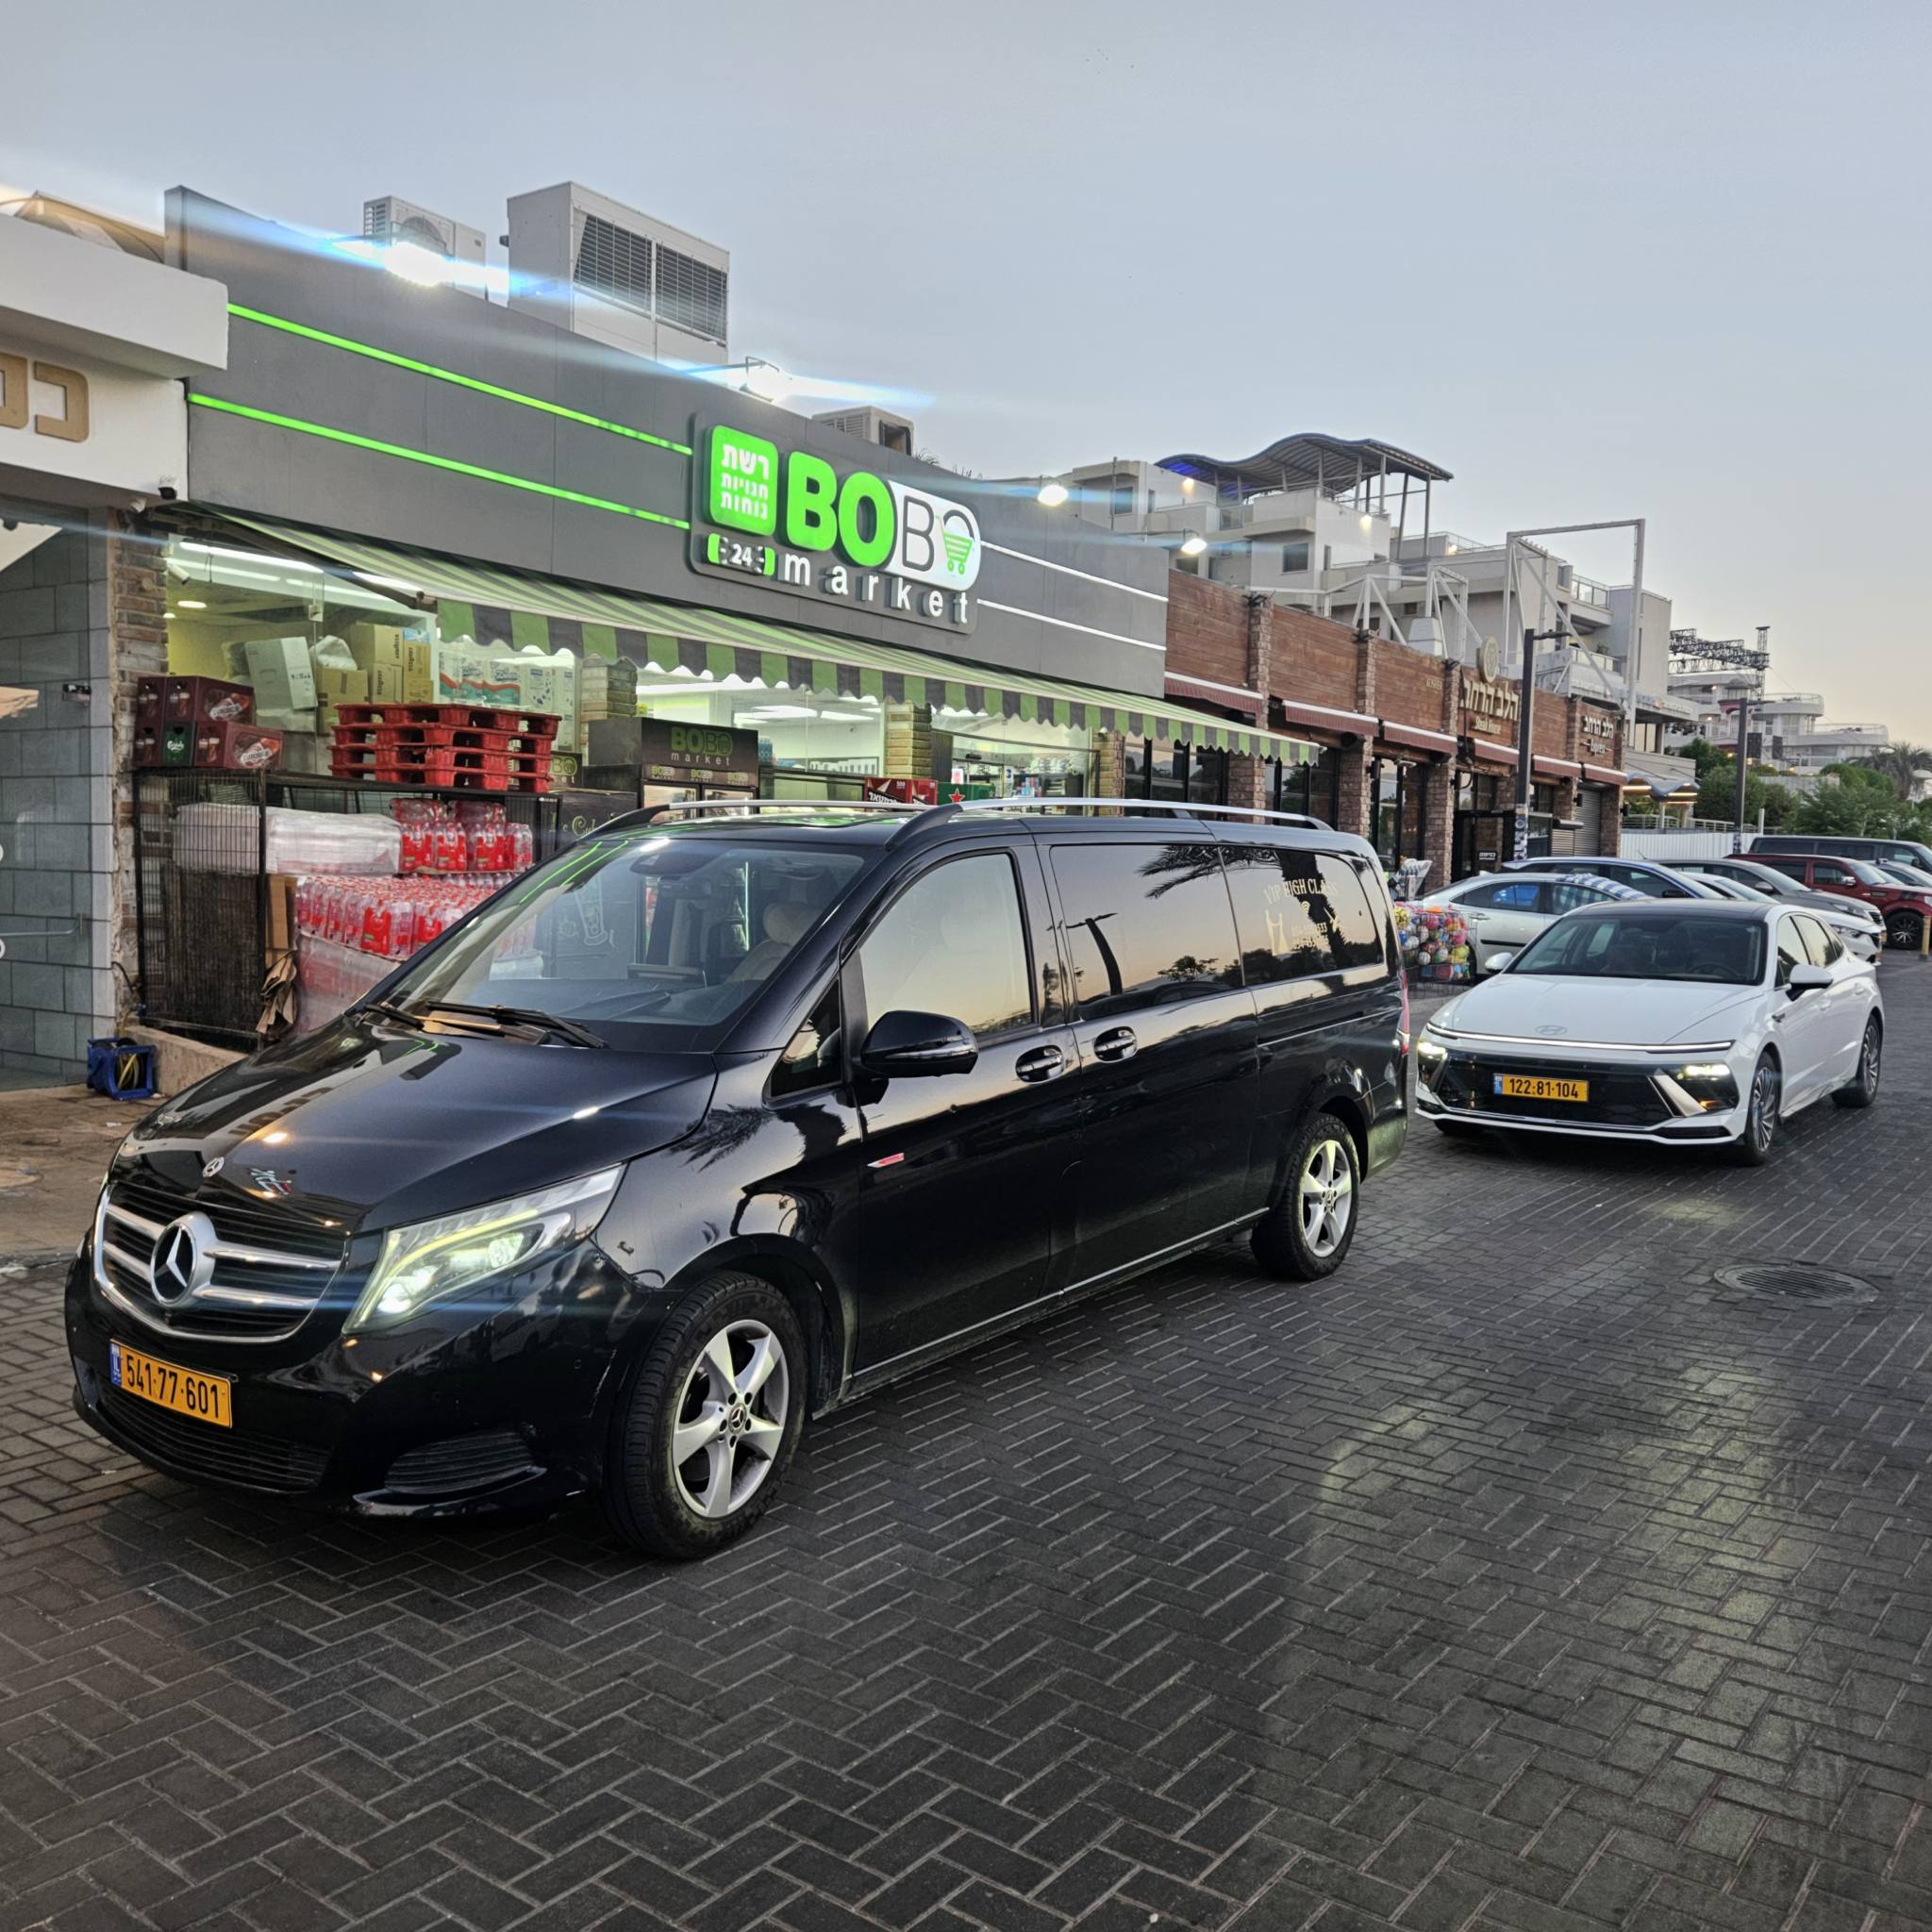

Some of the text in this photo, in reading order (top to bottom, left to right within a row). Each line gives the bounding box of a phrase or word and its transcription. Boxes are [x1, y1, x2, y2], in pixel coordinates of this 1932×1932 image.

[722, 443, 770, 480] רשת
[721, 473, 769, 500] חנויות
[721, 491, 768, 520] נוחות
[729, 542, 753, 566] 24
[783, 552, 969, 625] market
[671, 752, 730, 767] market
[1264, 883, 1281, 905] VIP
[1283, 877, 1307, 898] HIGH
